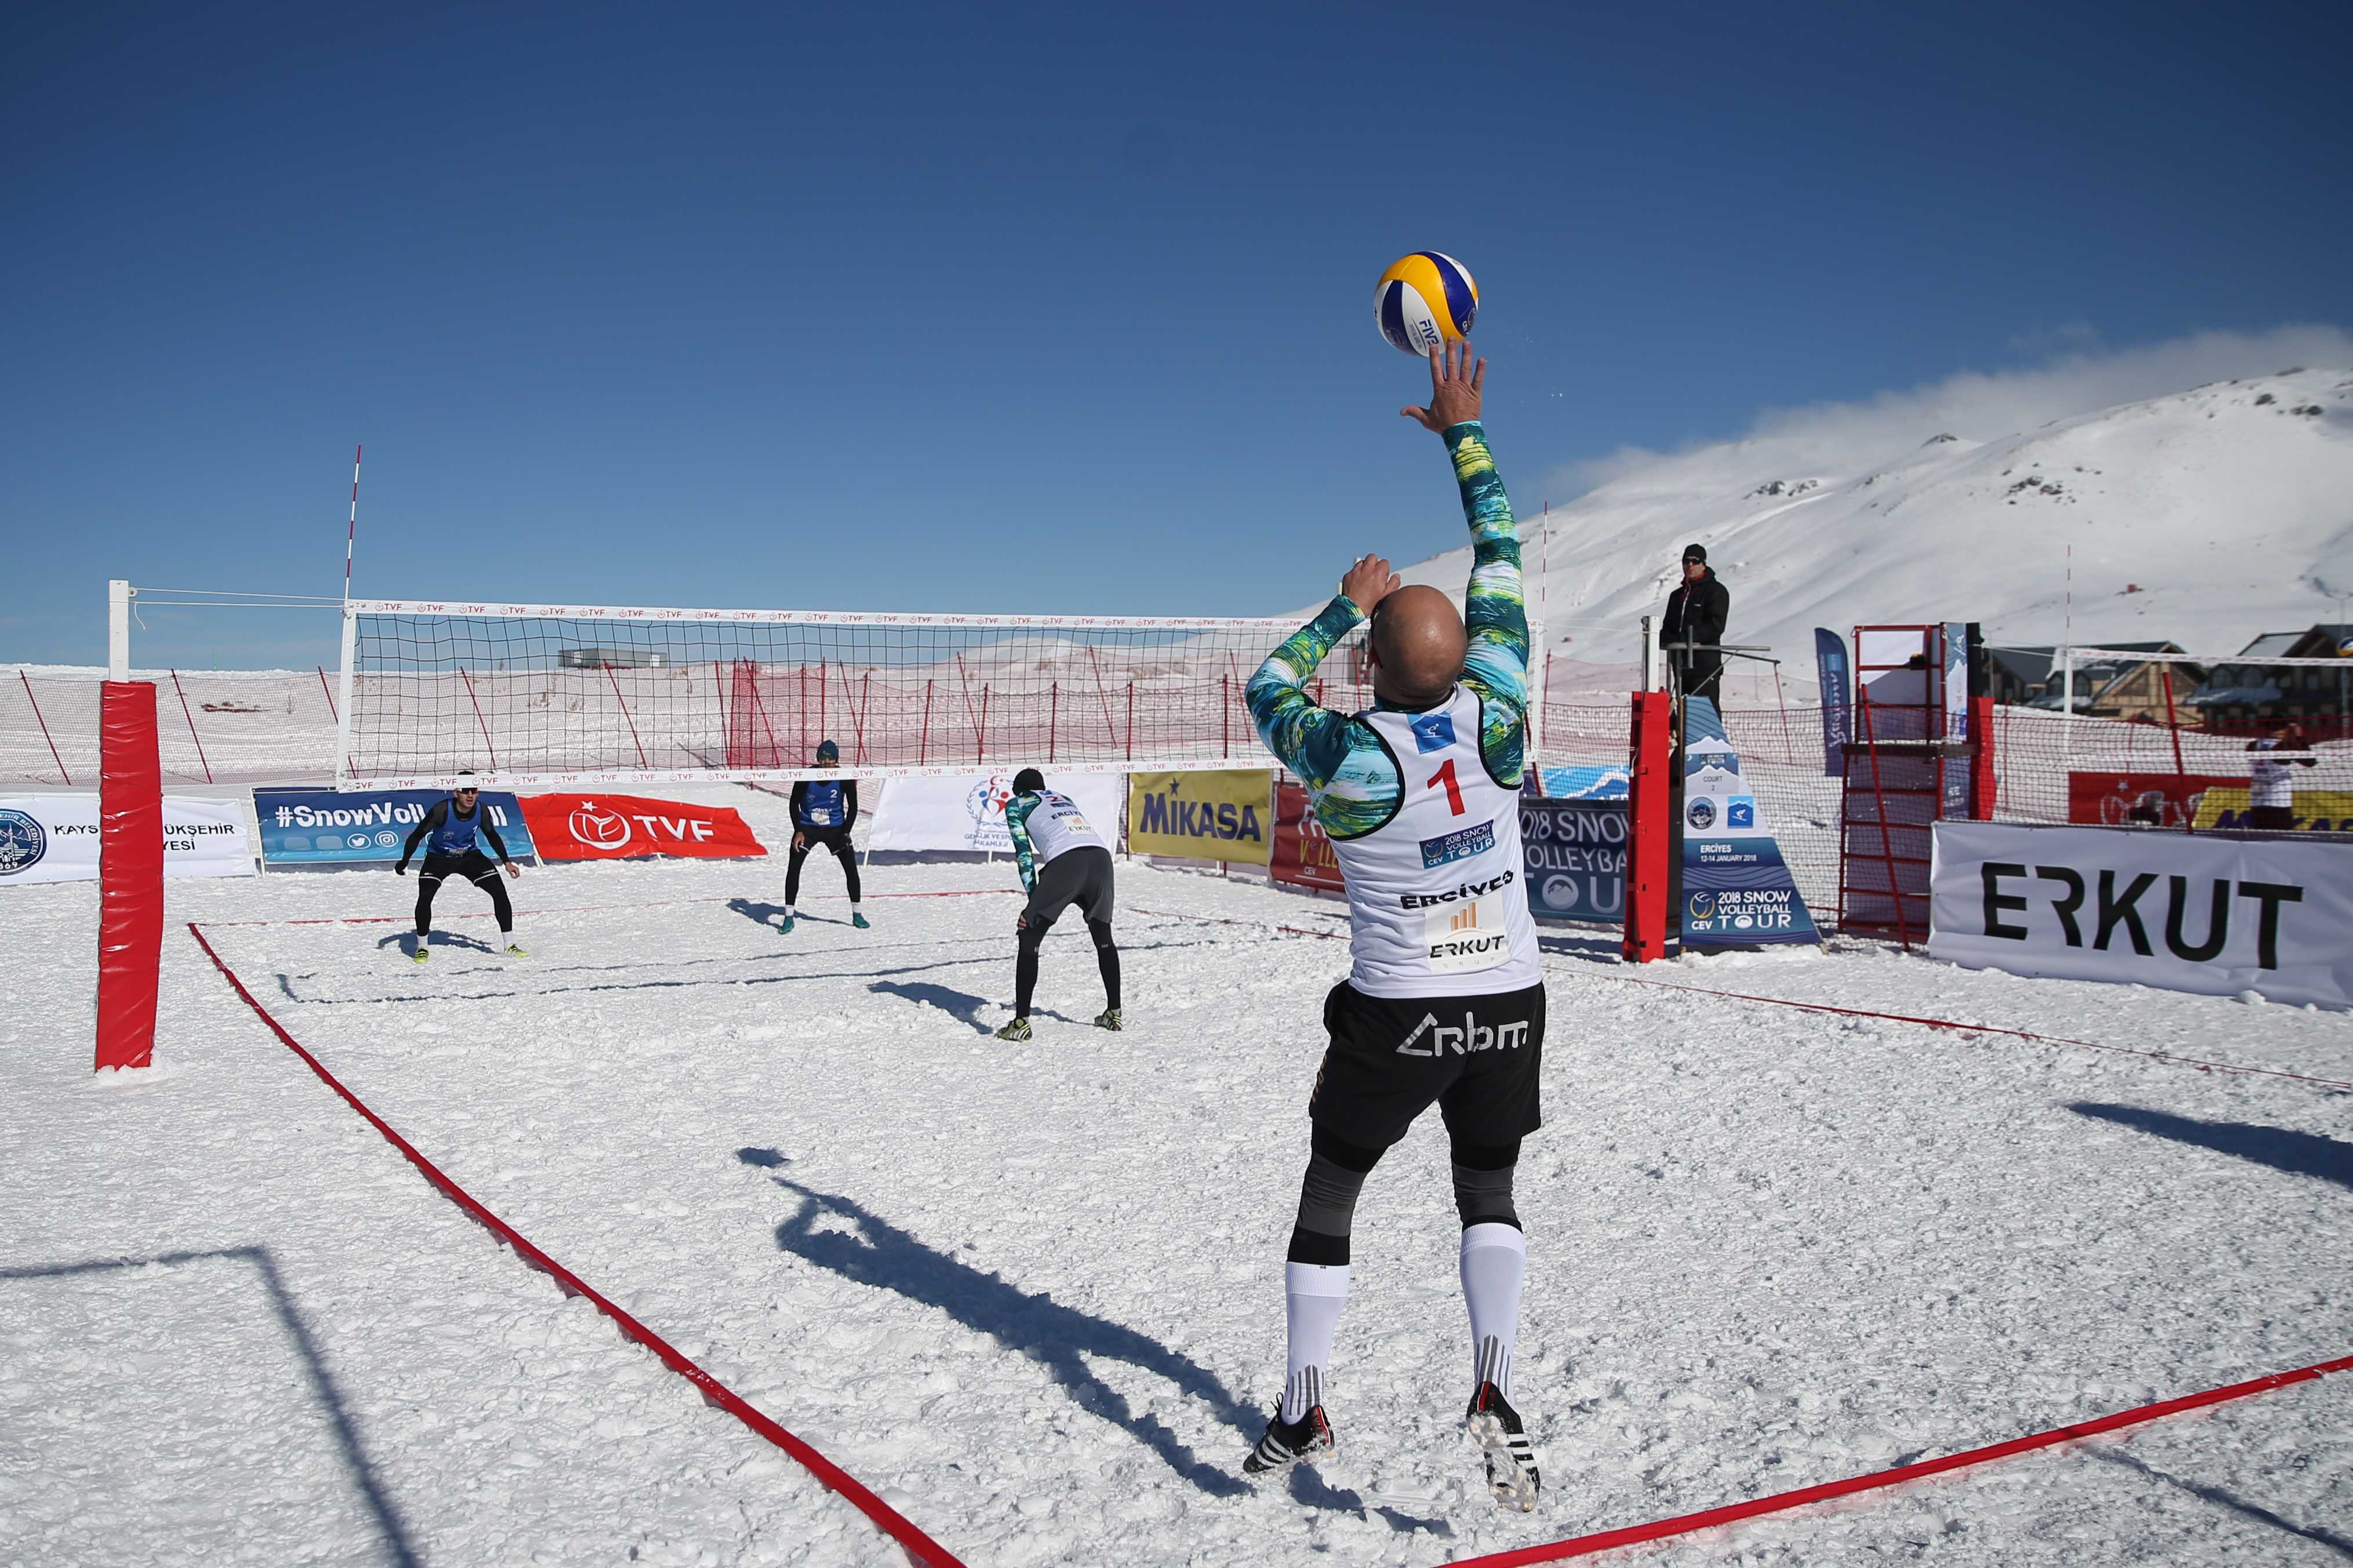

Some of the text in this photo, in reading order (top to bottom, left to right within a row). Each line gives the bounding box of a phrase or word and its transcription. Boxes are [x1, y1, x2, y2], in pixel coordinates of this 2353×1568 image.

[830, 790, 838, 798] 2
[1427, 758, 1466, 816] 1
[1139, 792, 1261, 842] MIKASA
[1520, 810, 1552, 839] 018
[54, 823, 235, 838] KAYS ÜKŞEHİR
[631, 815, 715, 842] TVF
[163, 838, 196, 850] YESİ
[1444, 834, 1462, 846] 2018
[1447, 831, 1491, 851] VOLLEYBALL
[1700, 843, 1732, 853] ERCİYES
[1447, 837, 1494, 860] TOUR
[1428, 856, 1443, 865] CEV
[1523, 844, 1627, 873] OLLEYBA
[1717, 890, 1792, 904] 2018 SNOW
[1718, 904, 1792, 915] VOLLEYBALL
[1981, 861, 2304, 970] ERKUT
[1691, 920, 1713, 930] CEV
[1717, 914, 1792, 930] TOUR
[1429, 934, 1505, 958] ERKUT
